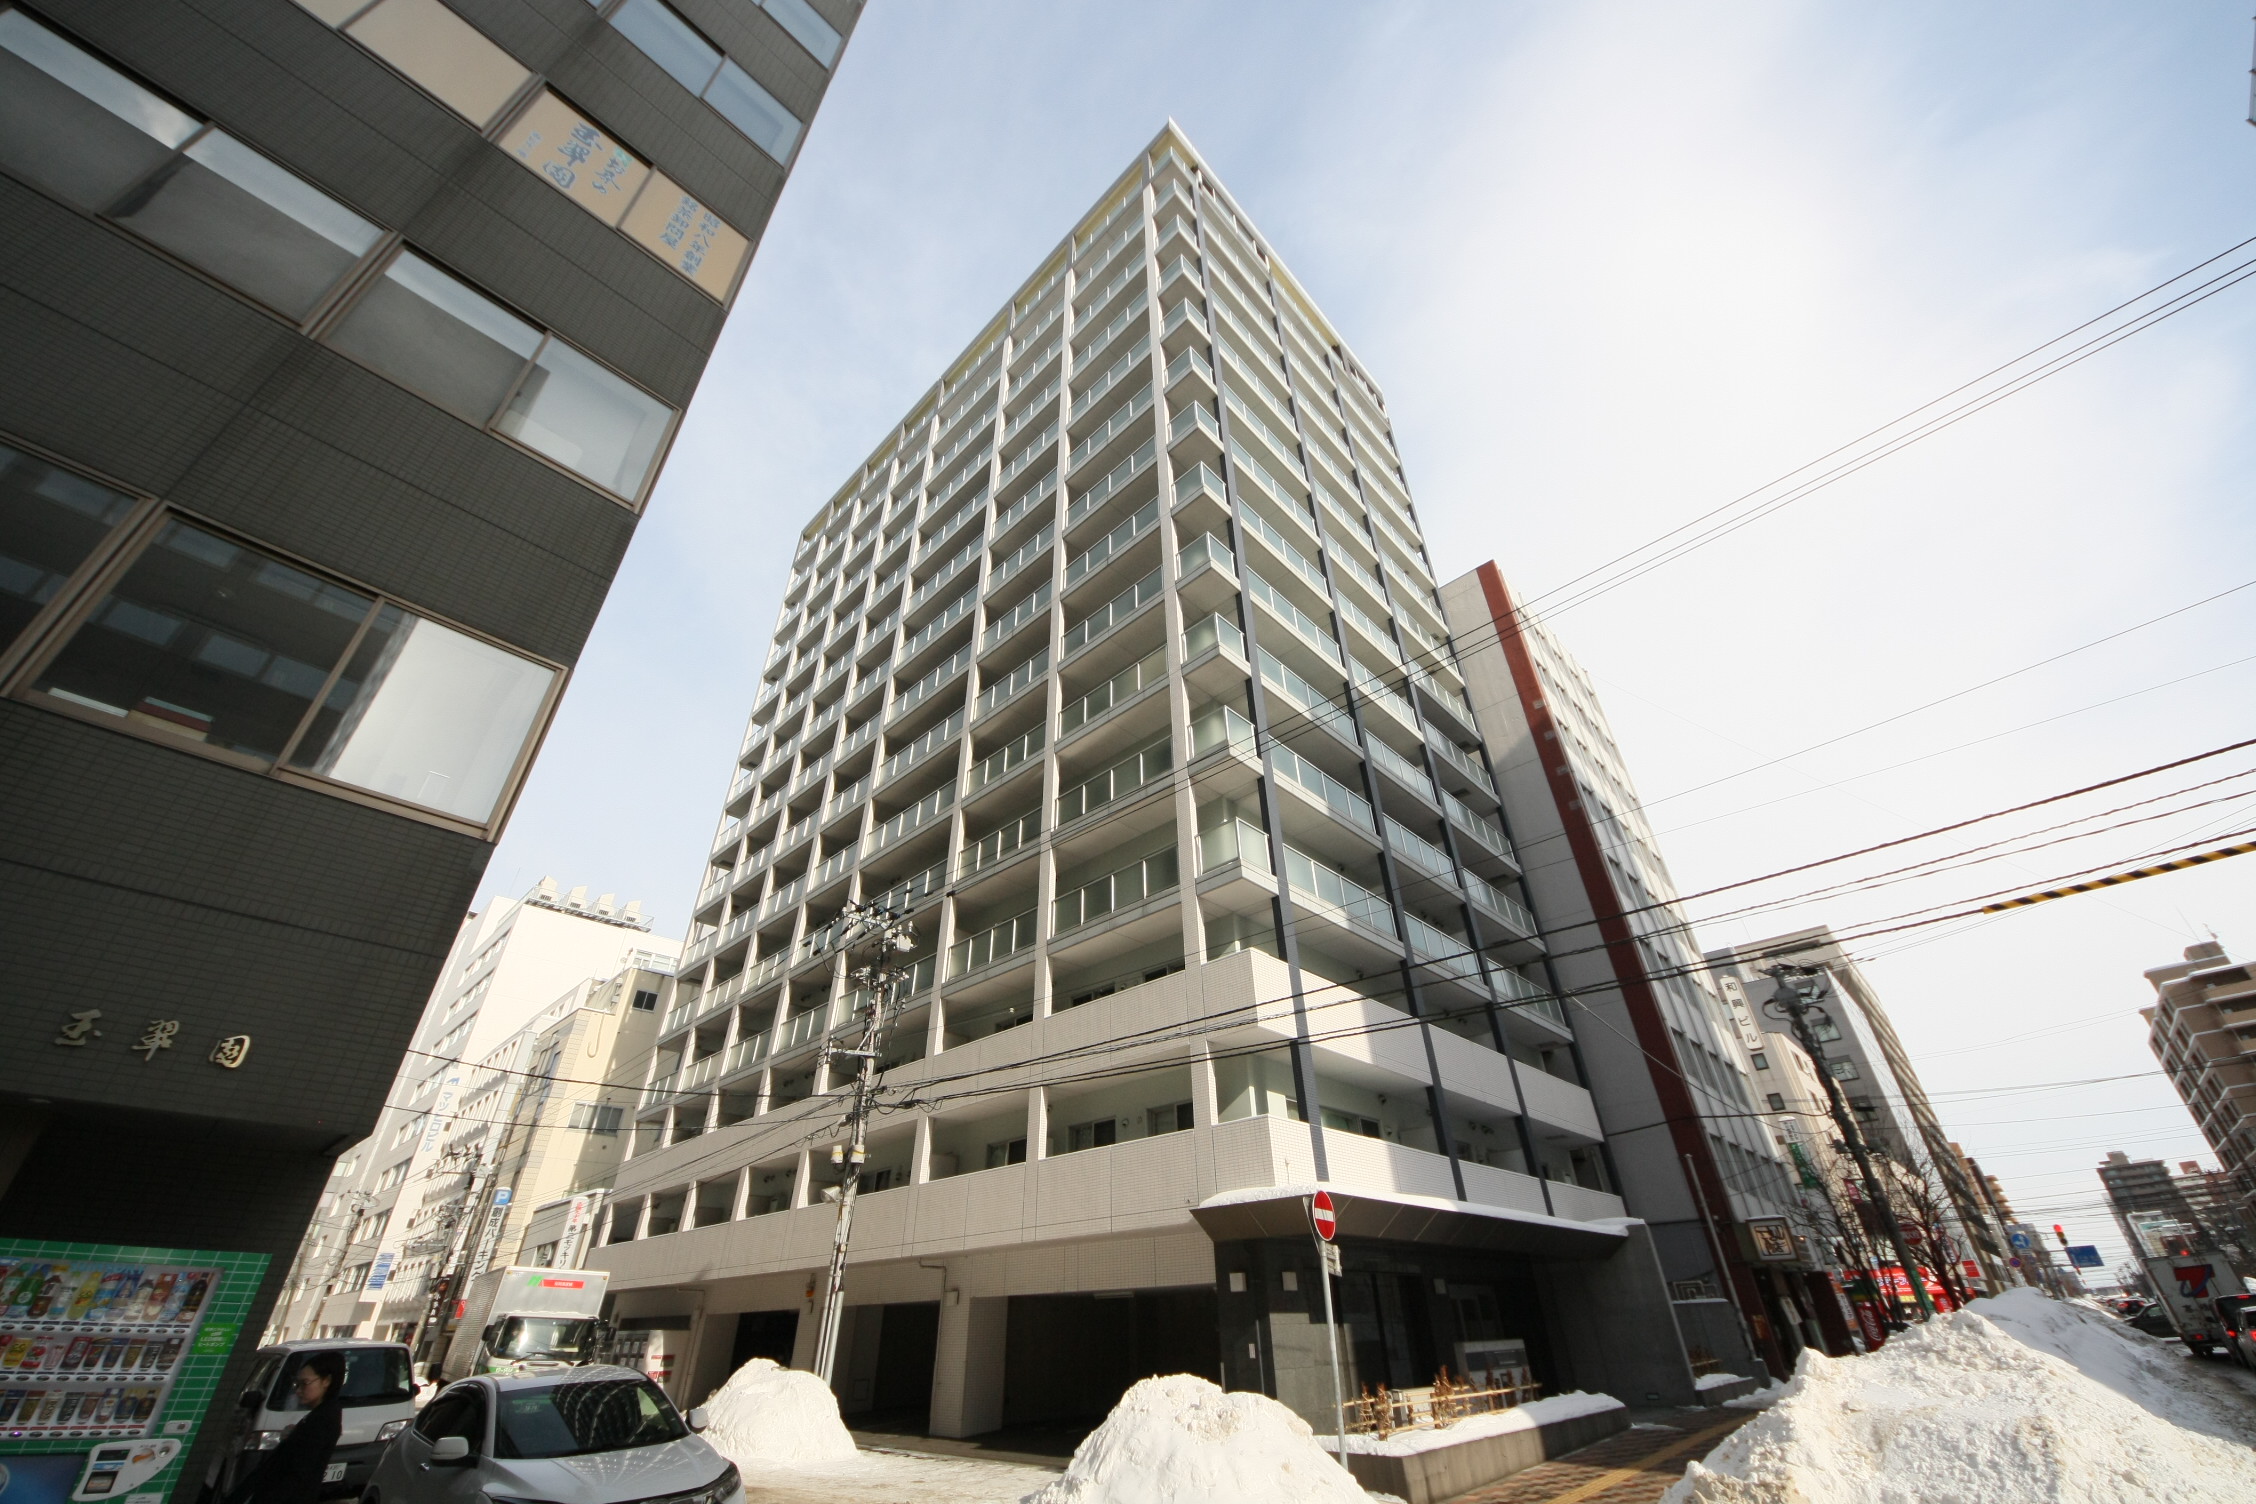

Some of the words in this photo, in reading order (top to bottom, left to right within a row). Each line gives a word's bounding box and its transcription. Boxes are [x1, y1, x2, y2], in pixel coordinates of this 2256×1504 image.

[681, 212, 721, 277] 昭和八年創業
[55, 1009, 250, 1068] 玉翠園
[495, 1191, 510, 1204] P
